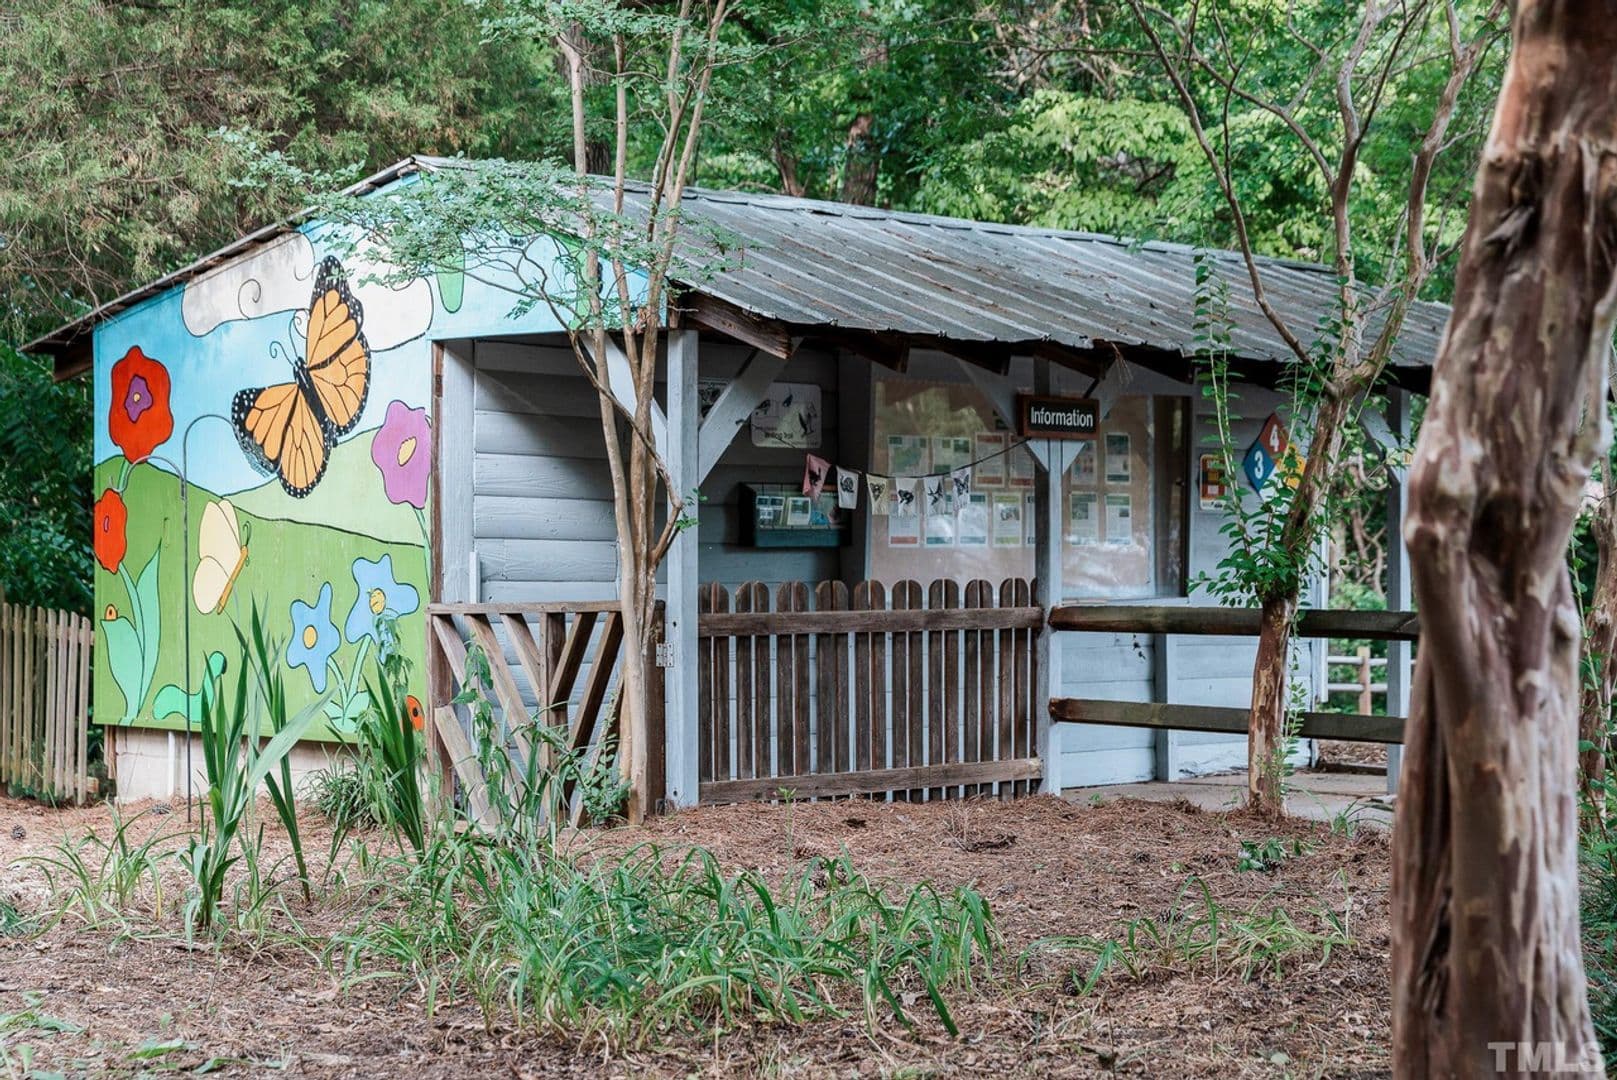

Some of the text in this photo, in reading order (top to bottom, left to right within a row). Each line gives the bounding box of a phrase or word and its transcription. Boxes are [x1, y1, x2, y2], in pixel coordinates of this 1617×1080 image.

[1030, 406, 1094, 428] Information
[1270, 424, 1280, 452] 4
[1254, 450, 1264, 480] 3
